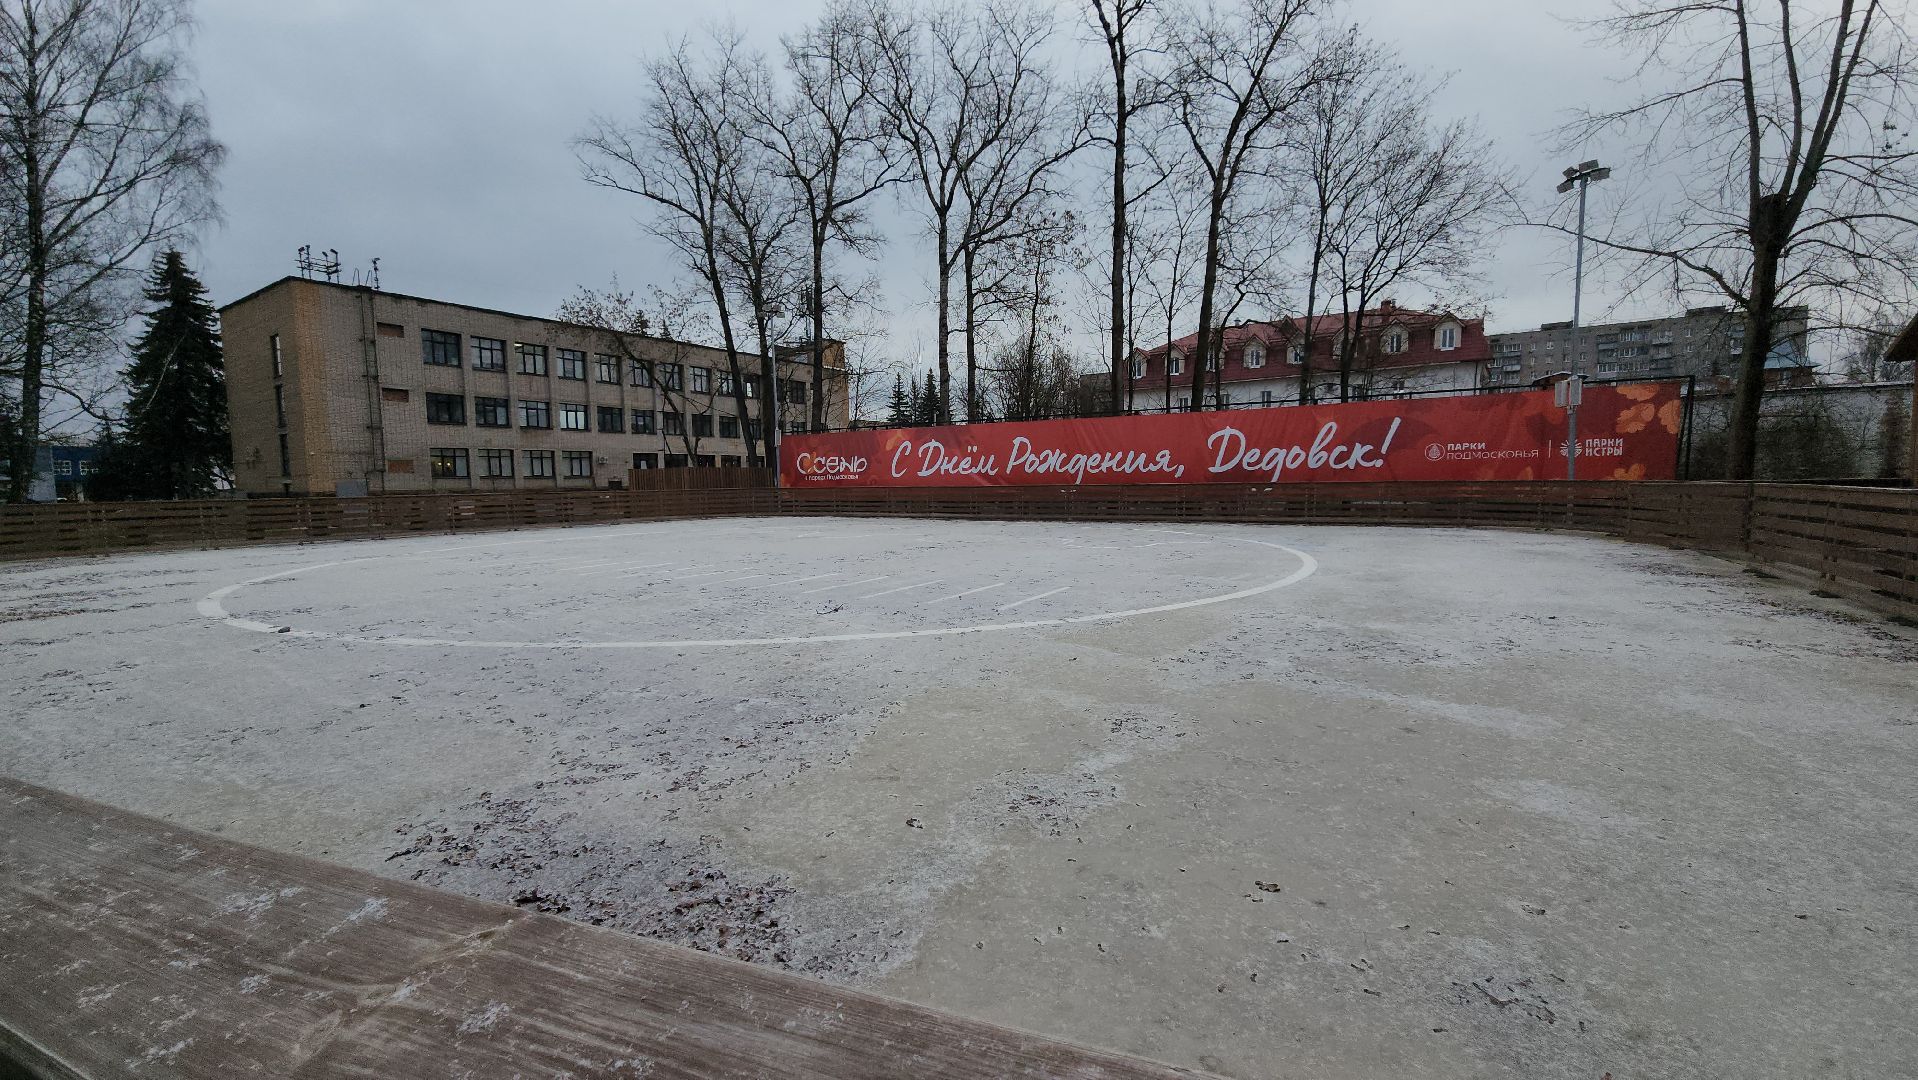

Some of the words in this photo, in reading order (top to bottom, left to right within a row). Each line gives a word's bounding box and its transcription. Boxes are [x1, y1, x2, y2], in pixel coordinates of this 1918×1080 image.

[1447, 442, 1486, 451] ПАРКИ
[1585, 438, 1624, 447] ПАРКИ
[891, 440, 912, 478] С
[917, 438, 999, 477] Днём
[1006, 436, 1185, 485] Рождения,
[1207, 416, 1402, 483] Дедовск!
[1446, 450, 1539, 460] ПОДМОСКОВЬЯ
[1585, 447, 1623, 457] ИСТРЫ
